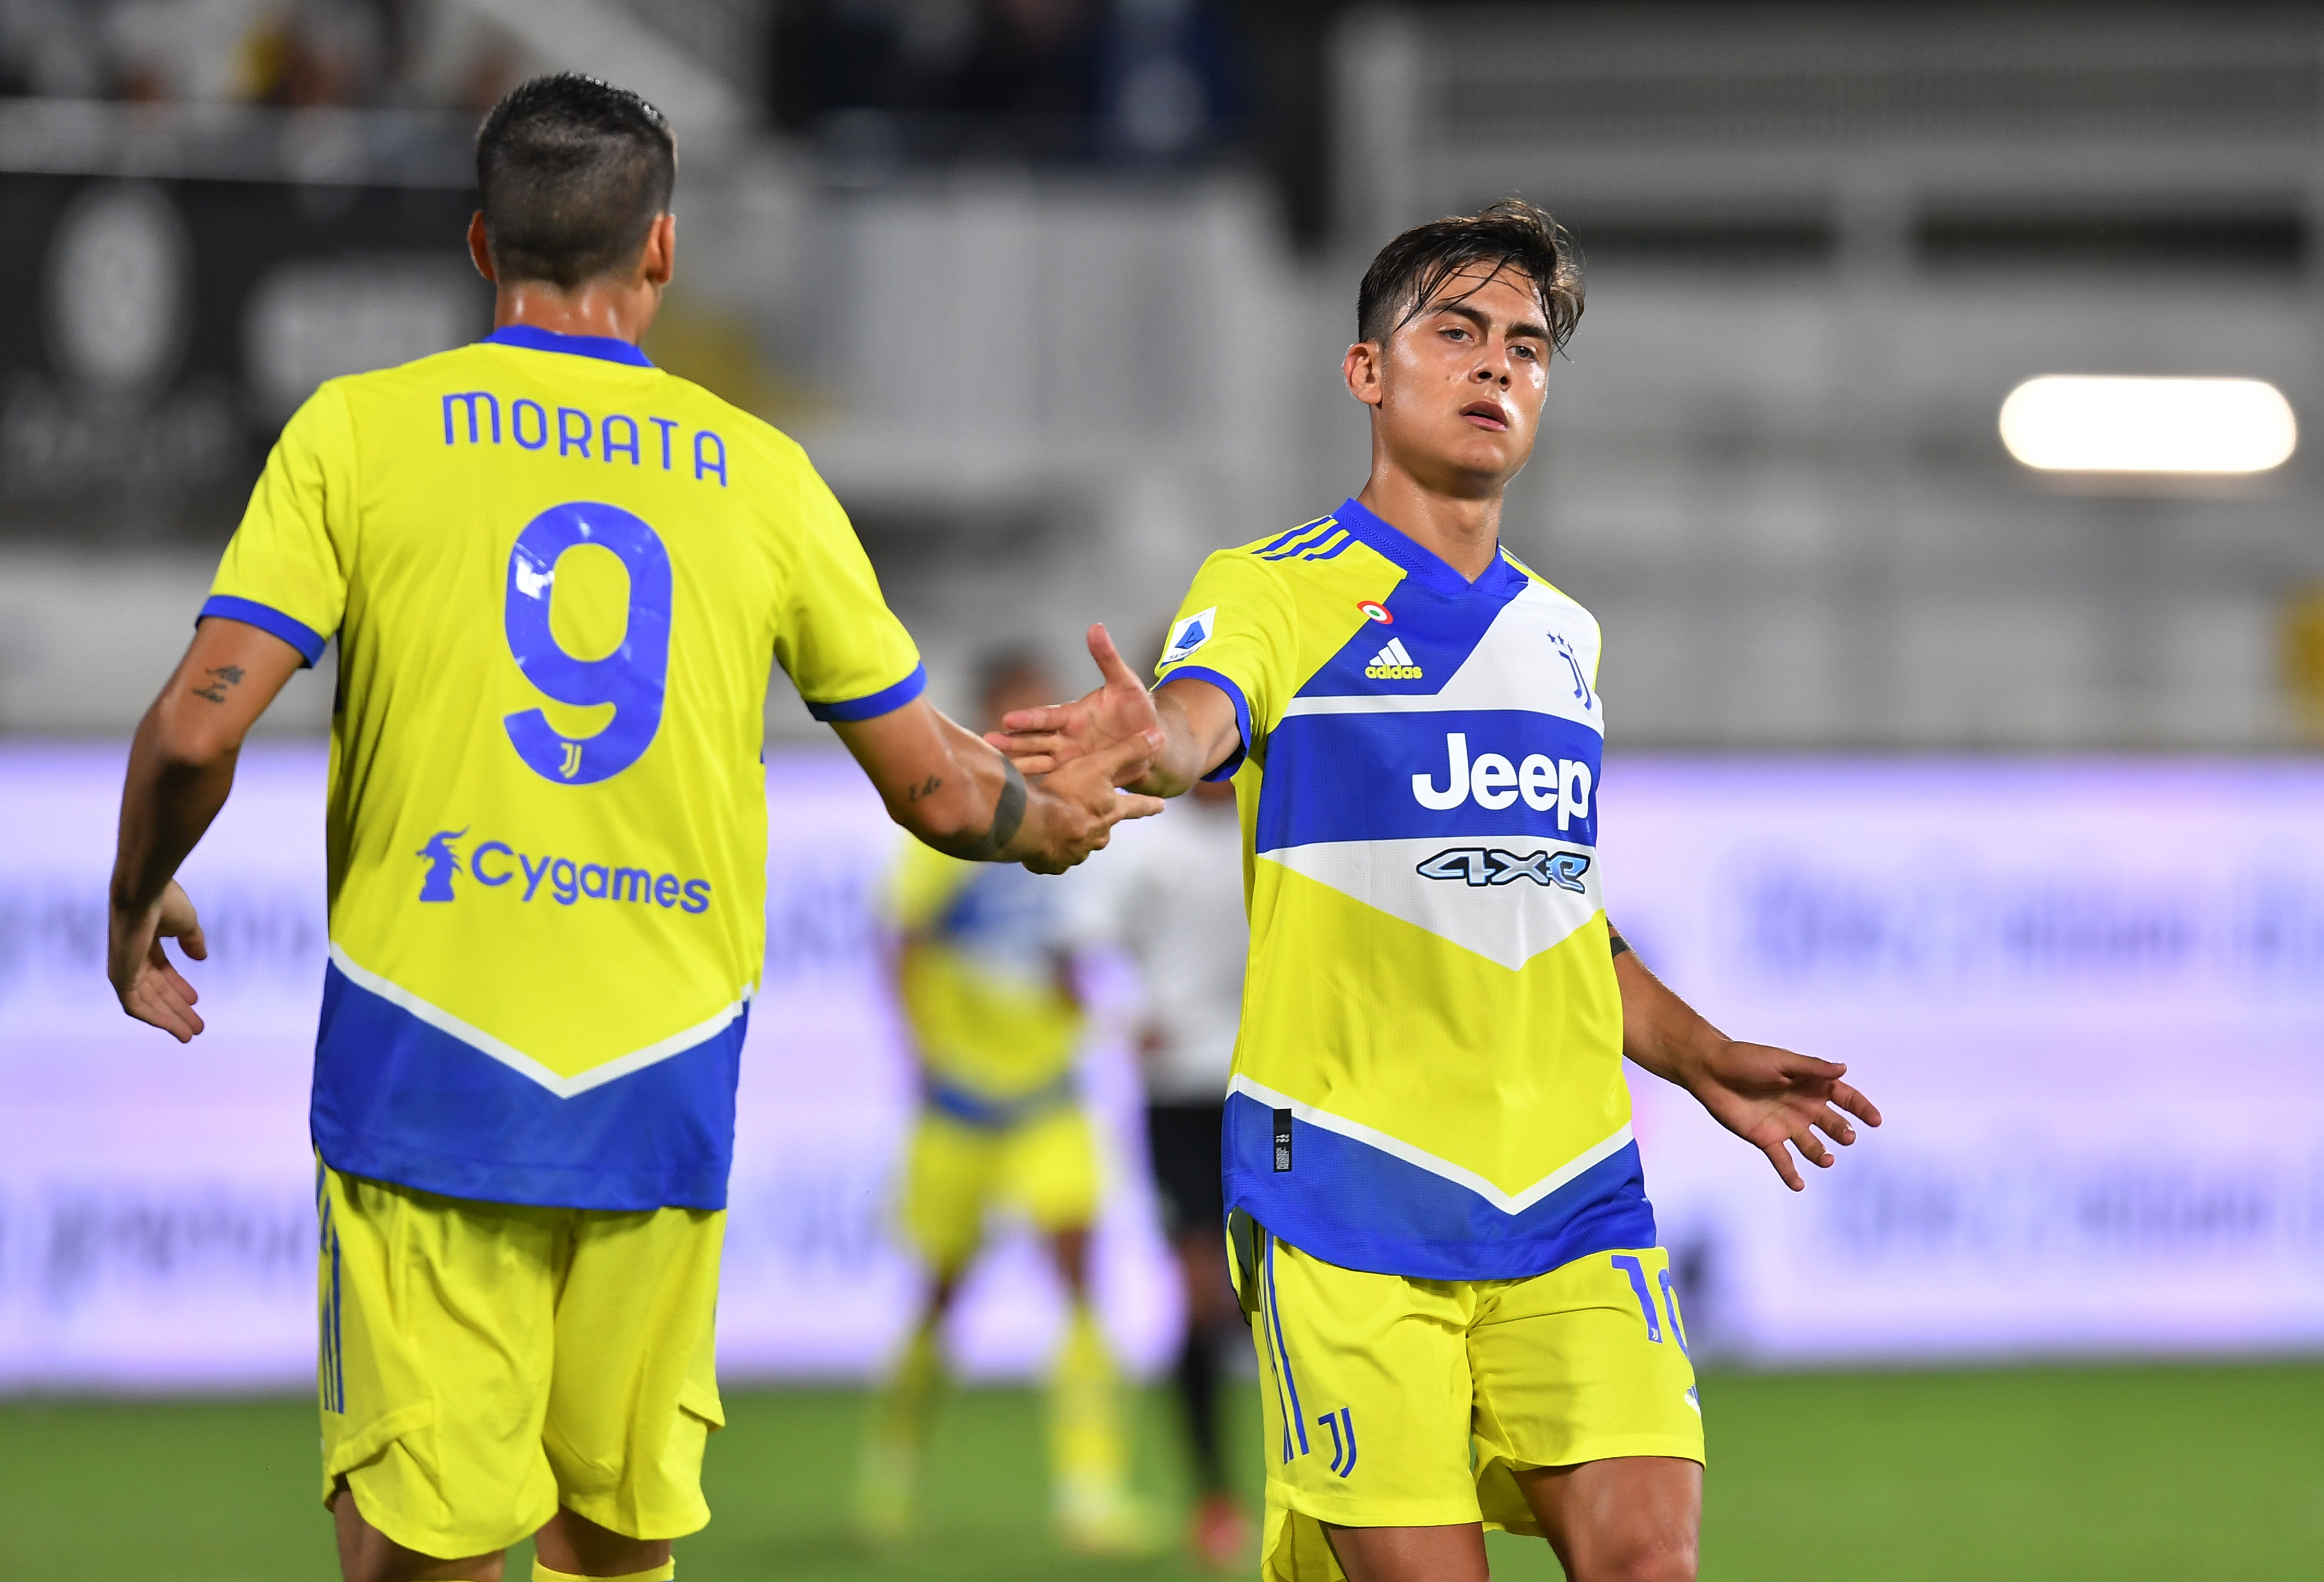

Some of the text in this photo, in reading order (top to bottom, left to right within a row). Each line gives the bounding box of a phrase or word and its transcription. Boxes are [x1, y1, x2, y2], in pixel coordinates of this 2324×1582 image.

[442, 390, 727, 487] MORATA
[503, 500, 673, 786] 9
[1365, 663, 1423, 679] adidas
[1412, 733, 1592, 831] Jeep
[471, 840, 711, 913] Cygames
